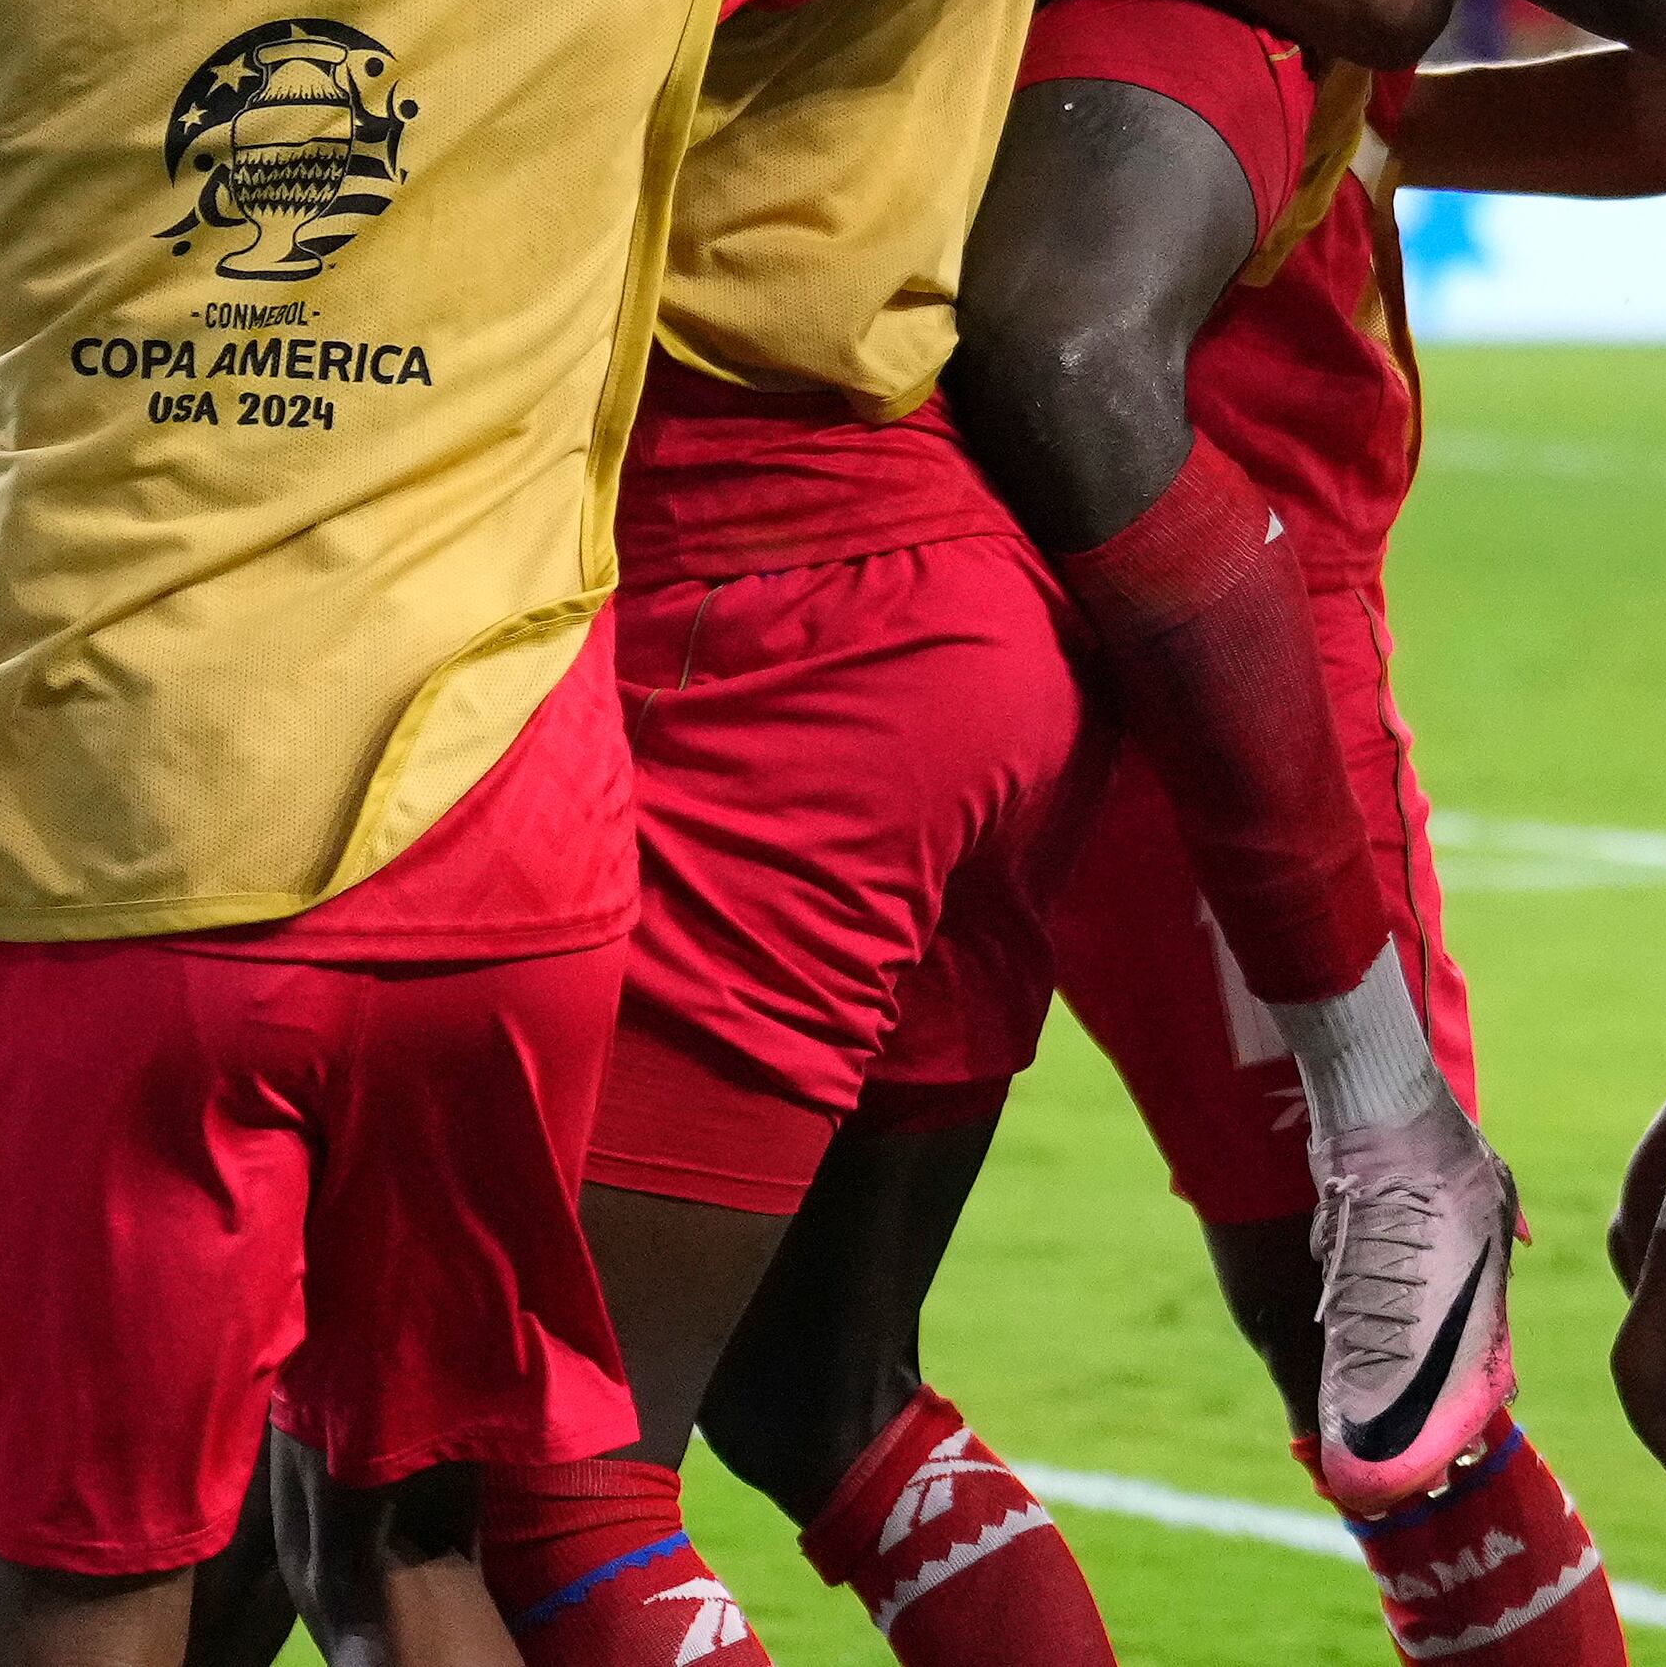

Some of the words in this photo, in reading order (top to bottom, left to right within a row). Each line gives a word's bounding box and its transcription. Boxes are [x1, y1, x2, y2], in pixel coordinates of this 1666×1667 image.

[70, 336, 198, 380] COPA
[205, 336, 434, 387] AMERICA
[146, 390, 219, 426] USA
[235, 391, 335, 431] 2024
